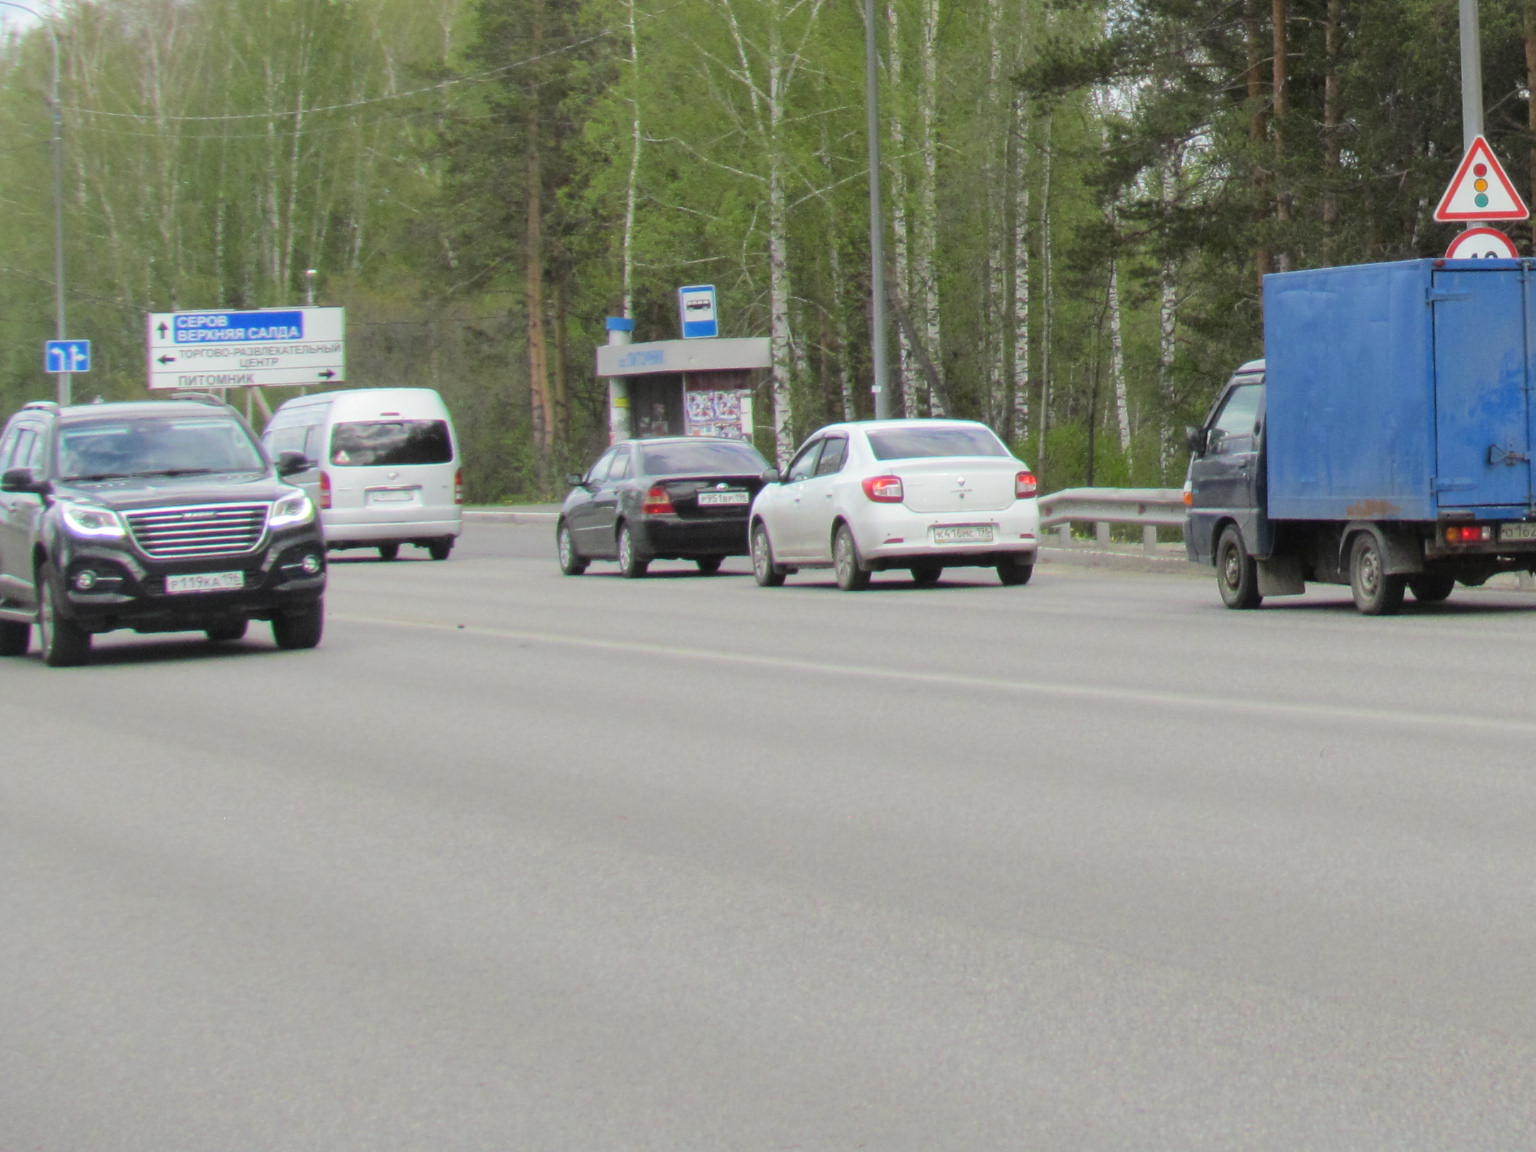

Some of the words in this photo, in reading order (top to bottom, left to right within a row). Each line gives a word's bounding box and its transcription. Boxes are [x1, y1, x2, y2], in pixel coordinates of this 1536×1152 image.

[176, 315, 228, 328] СЕРОВ
[176, 328, 245, 342] ВЕРХНЯЯ
[248, 326, 299, 340] САЛДА
[179, 343, 342, 359] ТОРГОВО-РАЗВЛЕКАТЕЛЬНЫЙ
[239, 357, 279, 368] ЦЕНТР
[178, 374, 255, 387] ПИТОМНИК
